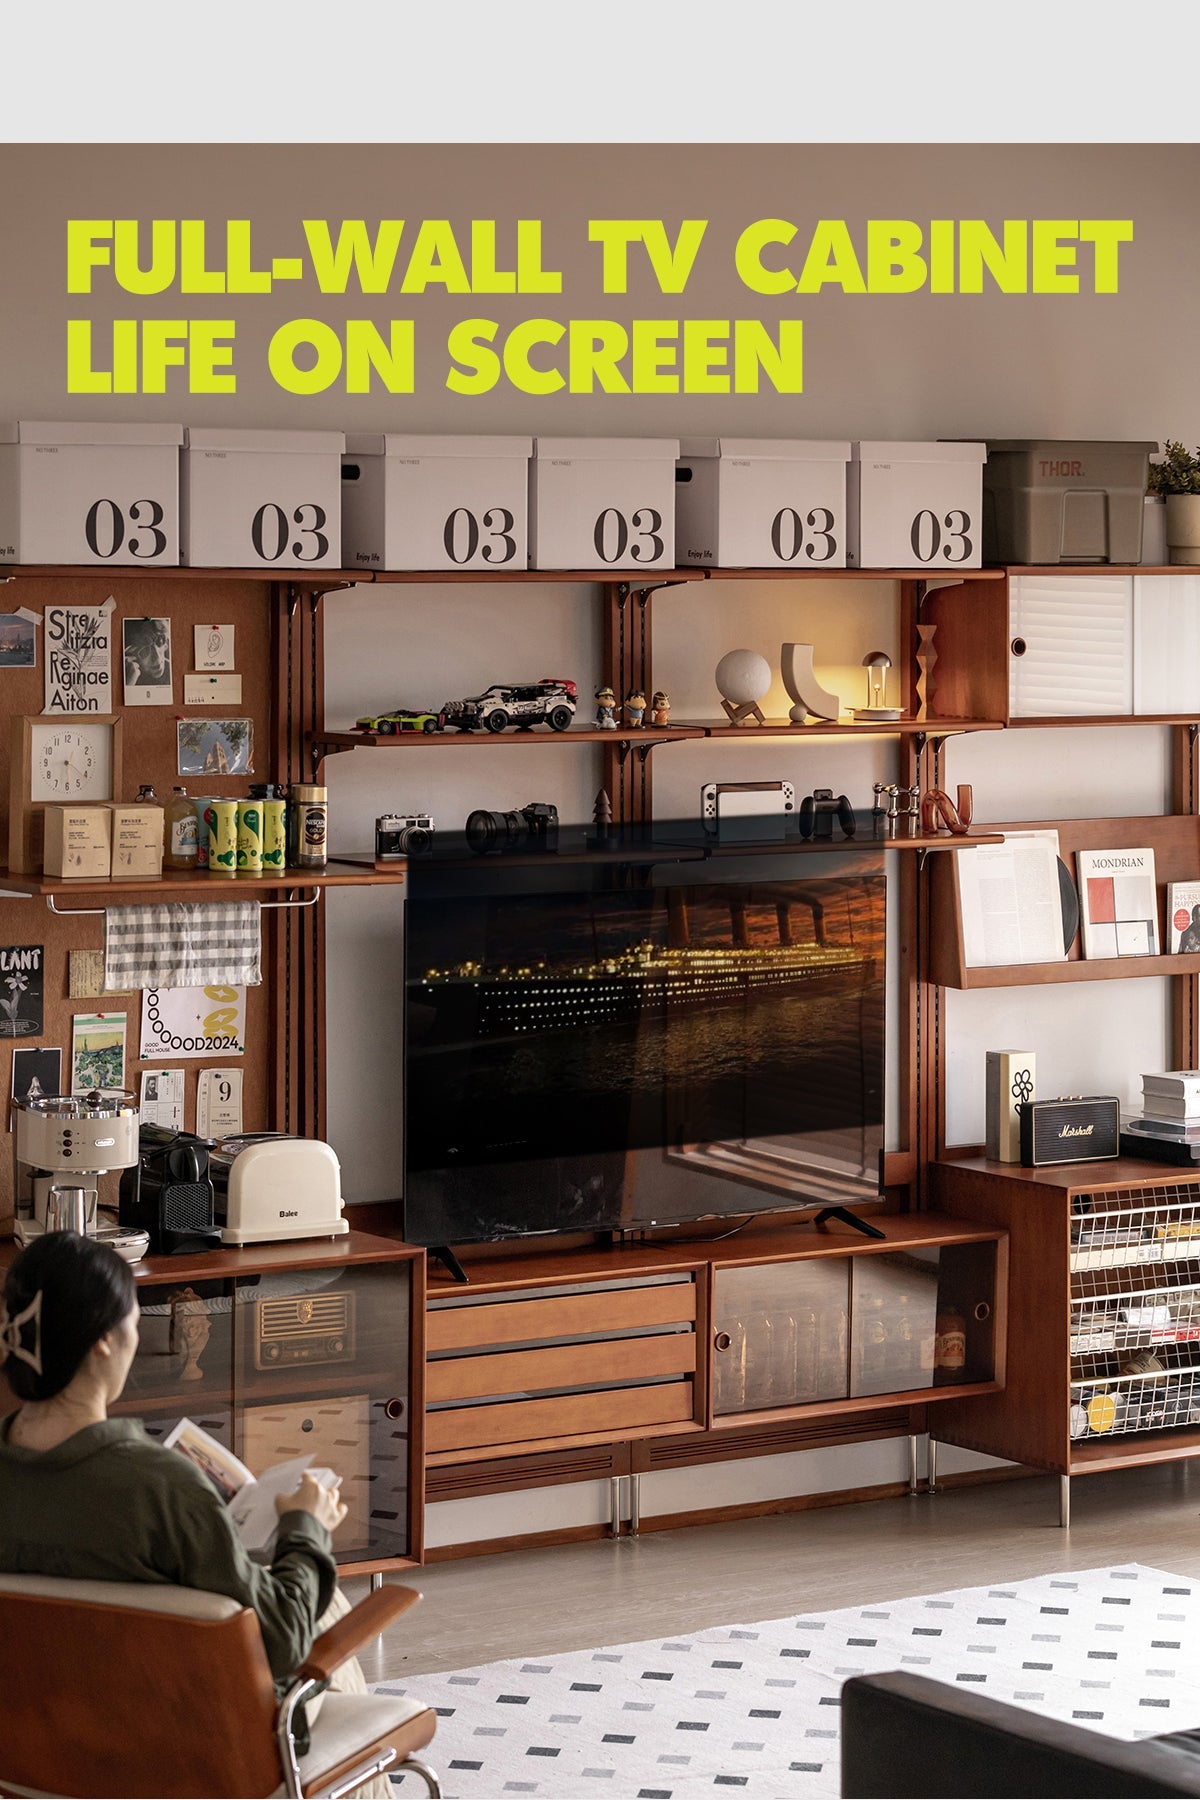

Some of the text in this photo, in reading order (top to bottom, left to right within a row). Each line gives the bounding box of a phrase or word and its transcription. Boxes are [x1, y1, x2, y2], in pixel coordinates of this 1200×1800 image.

[86, 499, 167, 558] 03
[251, 503, 329, 561] 03
[444, 508, 516, 564] 03
[594, 508, 664, 563] 03
[771, 507, 837, 561] 03
[910, 509, 972, 562] 03
[356, 552, 380, 562] Enjoy life
[688, 549, 713, 559] Enjoy life
[50, 689, 98, 711] Aiton
[54, 738, 59, 746] 11
[65, 735, 71, 743] 12
[45, 746, 53, 755] 10
[84, 746, 89, 755] 2
[43, 758, 48, 767] 9
[87, 758, 92, 767] 3
[46, 770, 51, 779] 8
[54, 779, 58, 788] 7
[65, 782, 70, 791] 6
[76, 779, 81, 788] 5
[1092, 857, 1144, 869] MONDRIAN
[0, 948, 41, 971] LANT
[219, 1081, 232, 1103] 9
[1058, 1124, 1094, 1138] Marshall
